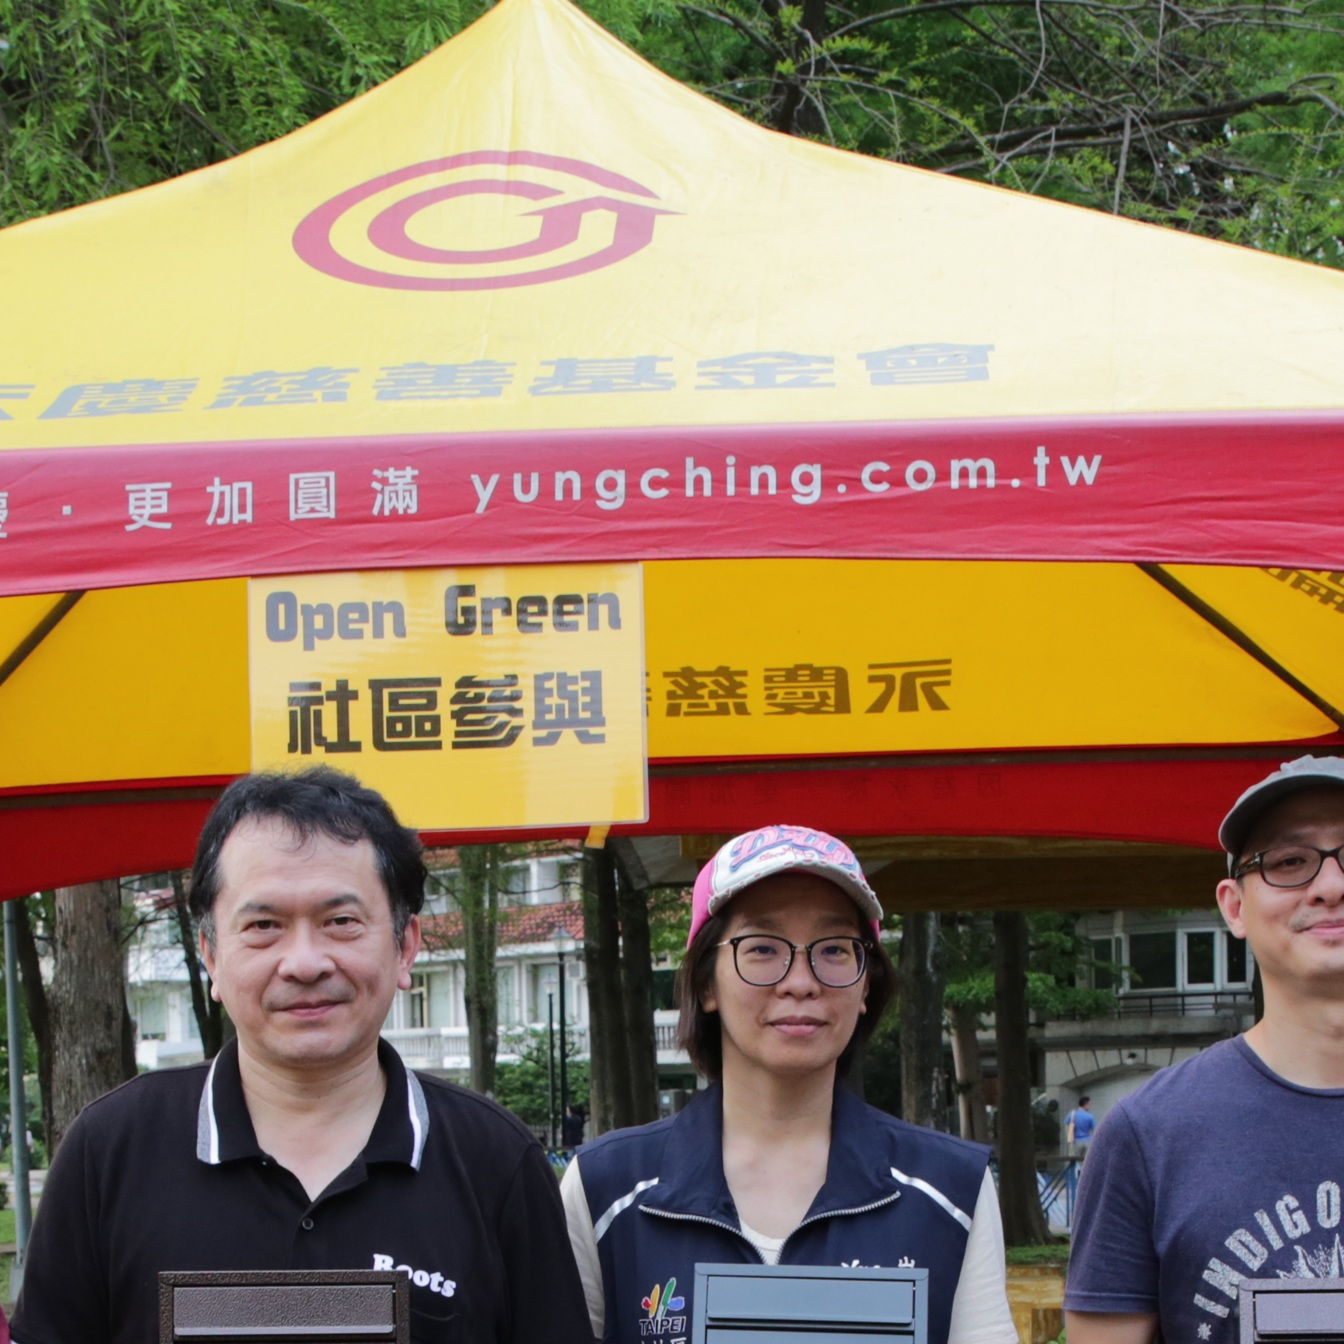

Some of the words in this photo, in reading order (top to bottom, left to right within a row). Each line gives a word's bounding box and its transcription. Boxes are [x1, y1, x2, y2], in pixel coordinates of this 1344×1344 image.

[470, 449, 1102, 513] yungching.com.tw
[263, 590, 408, 649] Open
[444, 580, 622, 637] Green
[286, 668, 608, 754] 社區參與
[1193, 1181, 1342, 1319] INDIGO
[639, 1316, 686, 1335] TAIPEI
